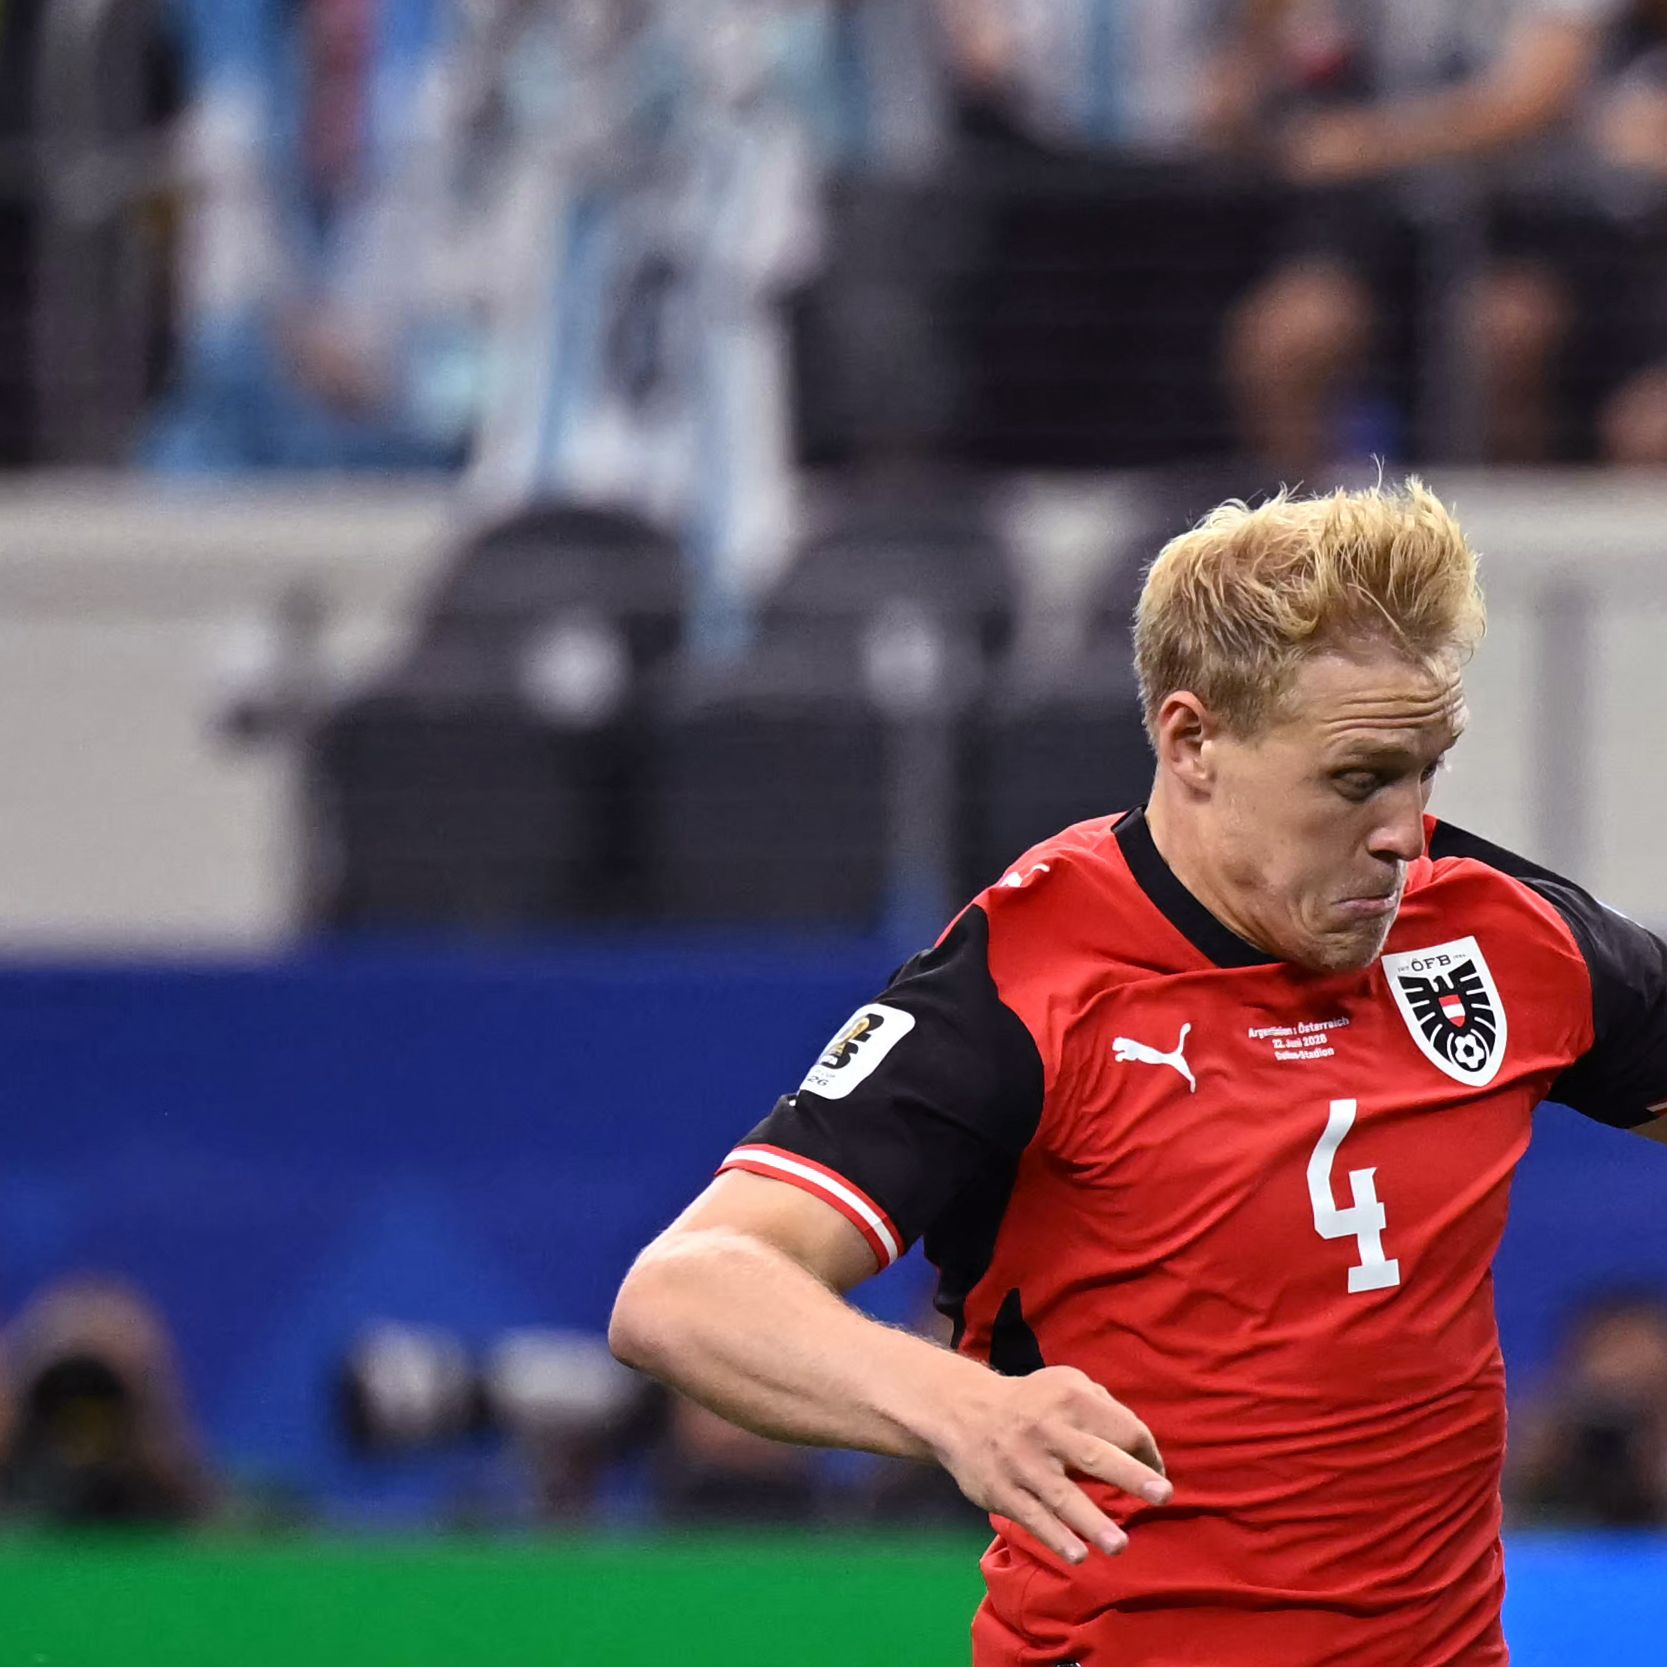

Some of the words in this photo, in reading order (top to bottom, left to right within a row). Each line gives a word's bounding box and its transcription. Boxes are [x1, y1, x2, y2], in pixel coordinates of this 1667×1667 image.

[1410, 954, 1452, 972] ÖFB
[1298, 1016, 1350, 1034] Österreich
[1306, 1098, 1400, 1293] 4
